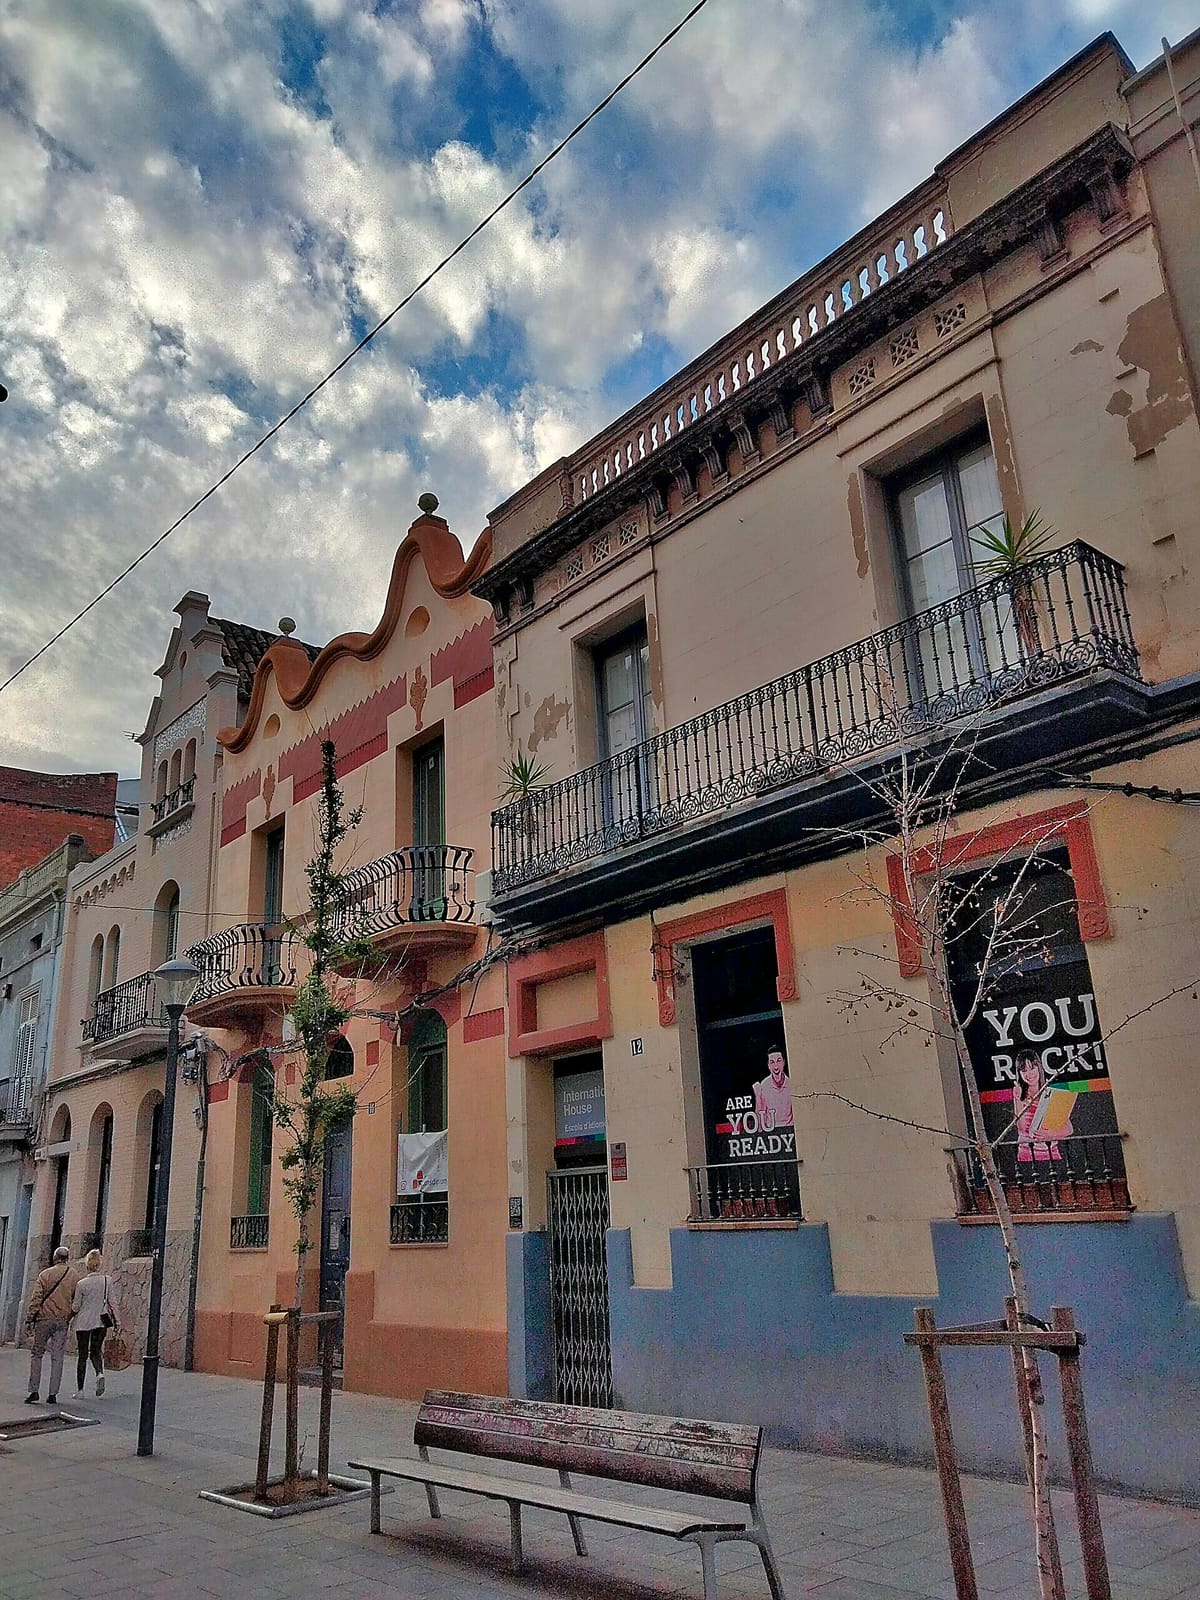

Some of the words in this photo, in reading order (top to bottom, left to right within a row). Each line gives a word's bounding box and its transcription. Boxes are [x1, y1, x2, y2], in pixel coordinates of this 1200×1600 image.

[983, 994, 1095, 1047] YOU
[632, 1039, 642, 1055] 12
[991, 1041, 1104, 1082] RCK!
[563, 1103, 592, 1117] House
[725, 1095, 753, 1111] ARE
[726, 1109, 776, 1135] YOU
[728, 1133, 795, 1157] READY
